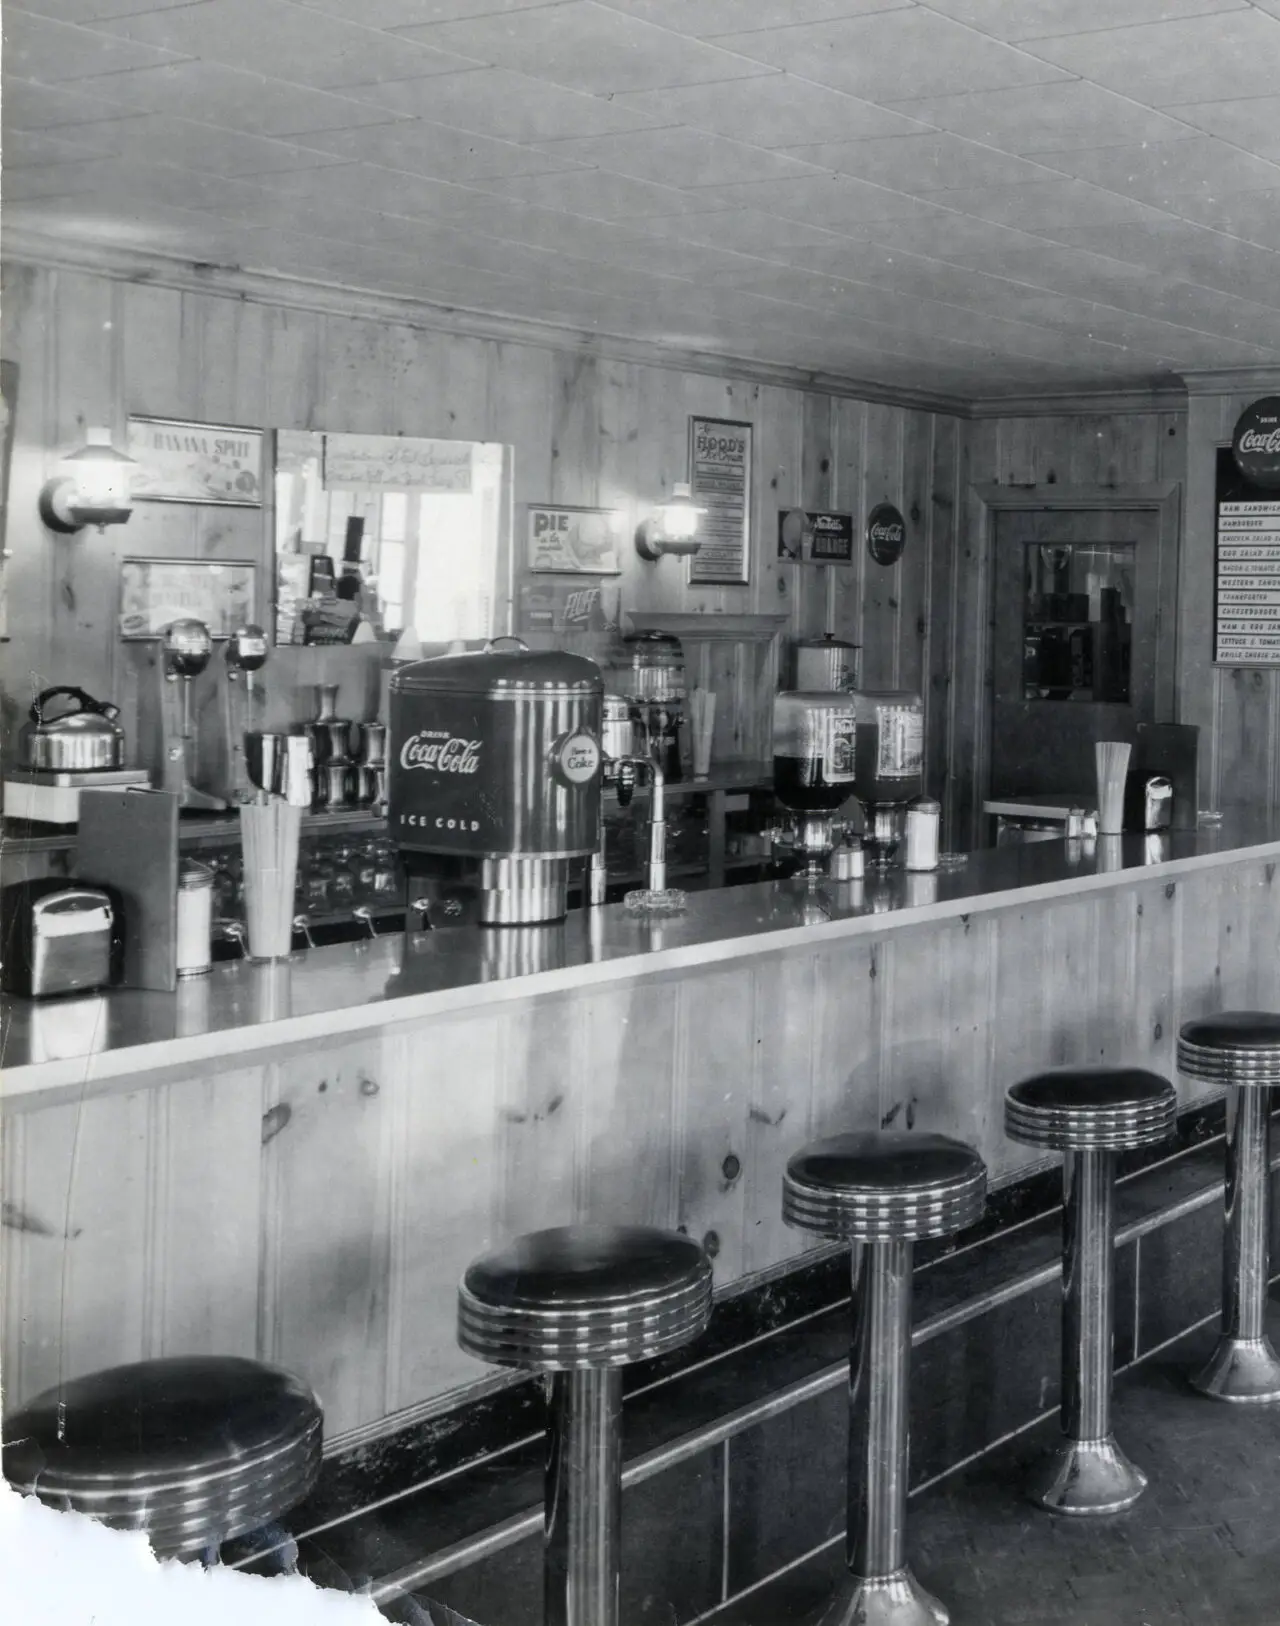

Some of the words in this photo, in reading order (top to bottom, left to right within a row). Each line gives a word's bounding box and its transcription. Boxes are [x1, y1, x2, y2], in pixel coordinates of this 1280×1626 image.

[154, 433, 208, 454] BANANA
[214, 439, 249, 457] SPLIT
[534, 513, 569, 538] PIE
[400, 735, 483, 775] Coca-Cola
[400, 814, 427, 827] ICE
[435, 817, 480, 832] COLD
